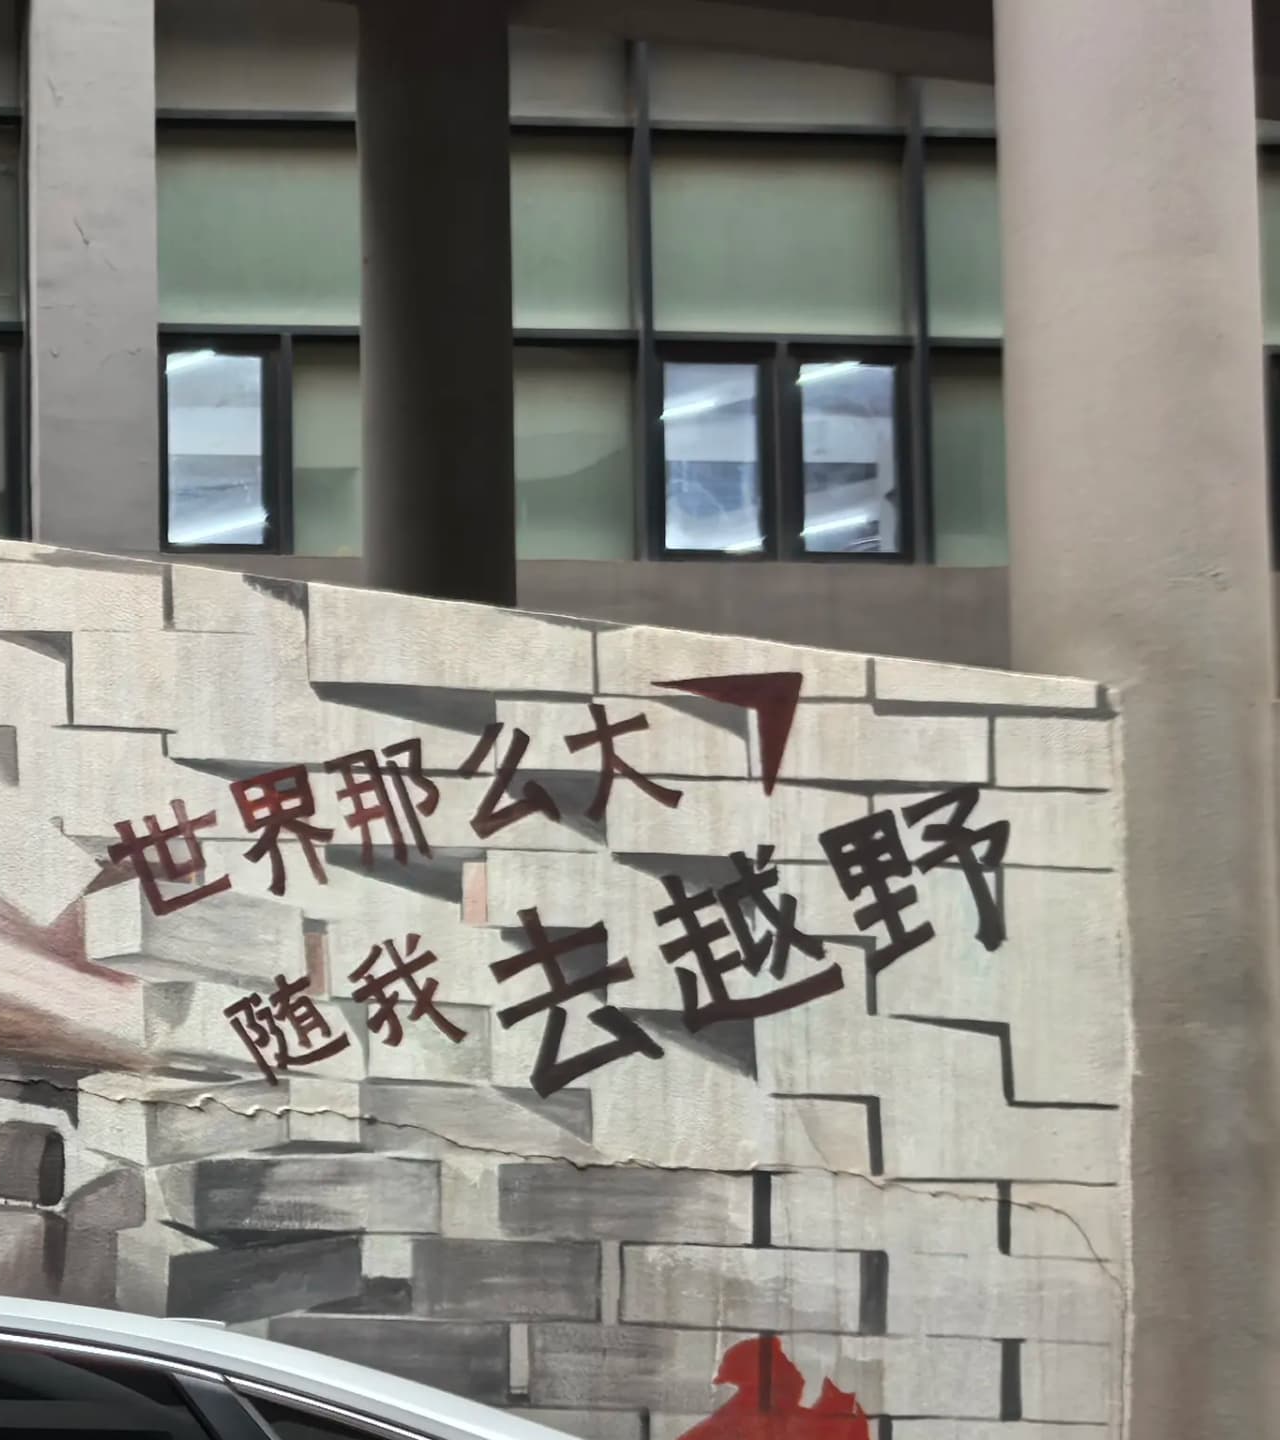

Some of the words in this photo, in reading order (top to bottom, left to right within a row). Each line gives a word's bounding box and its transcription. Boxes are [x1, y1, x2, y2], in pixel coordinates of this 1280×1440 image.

[107, 702, 683, 916] 世界那么大
[226, 785, 1011, 1098] 随我去越野
